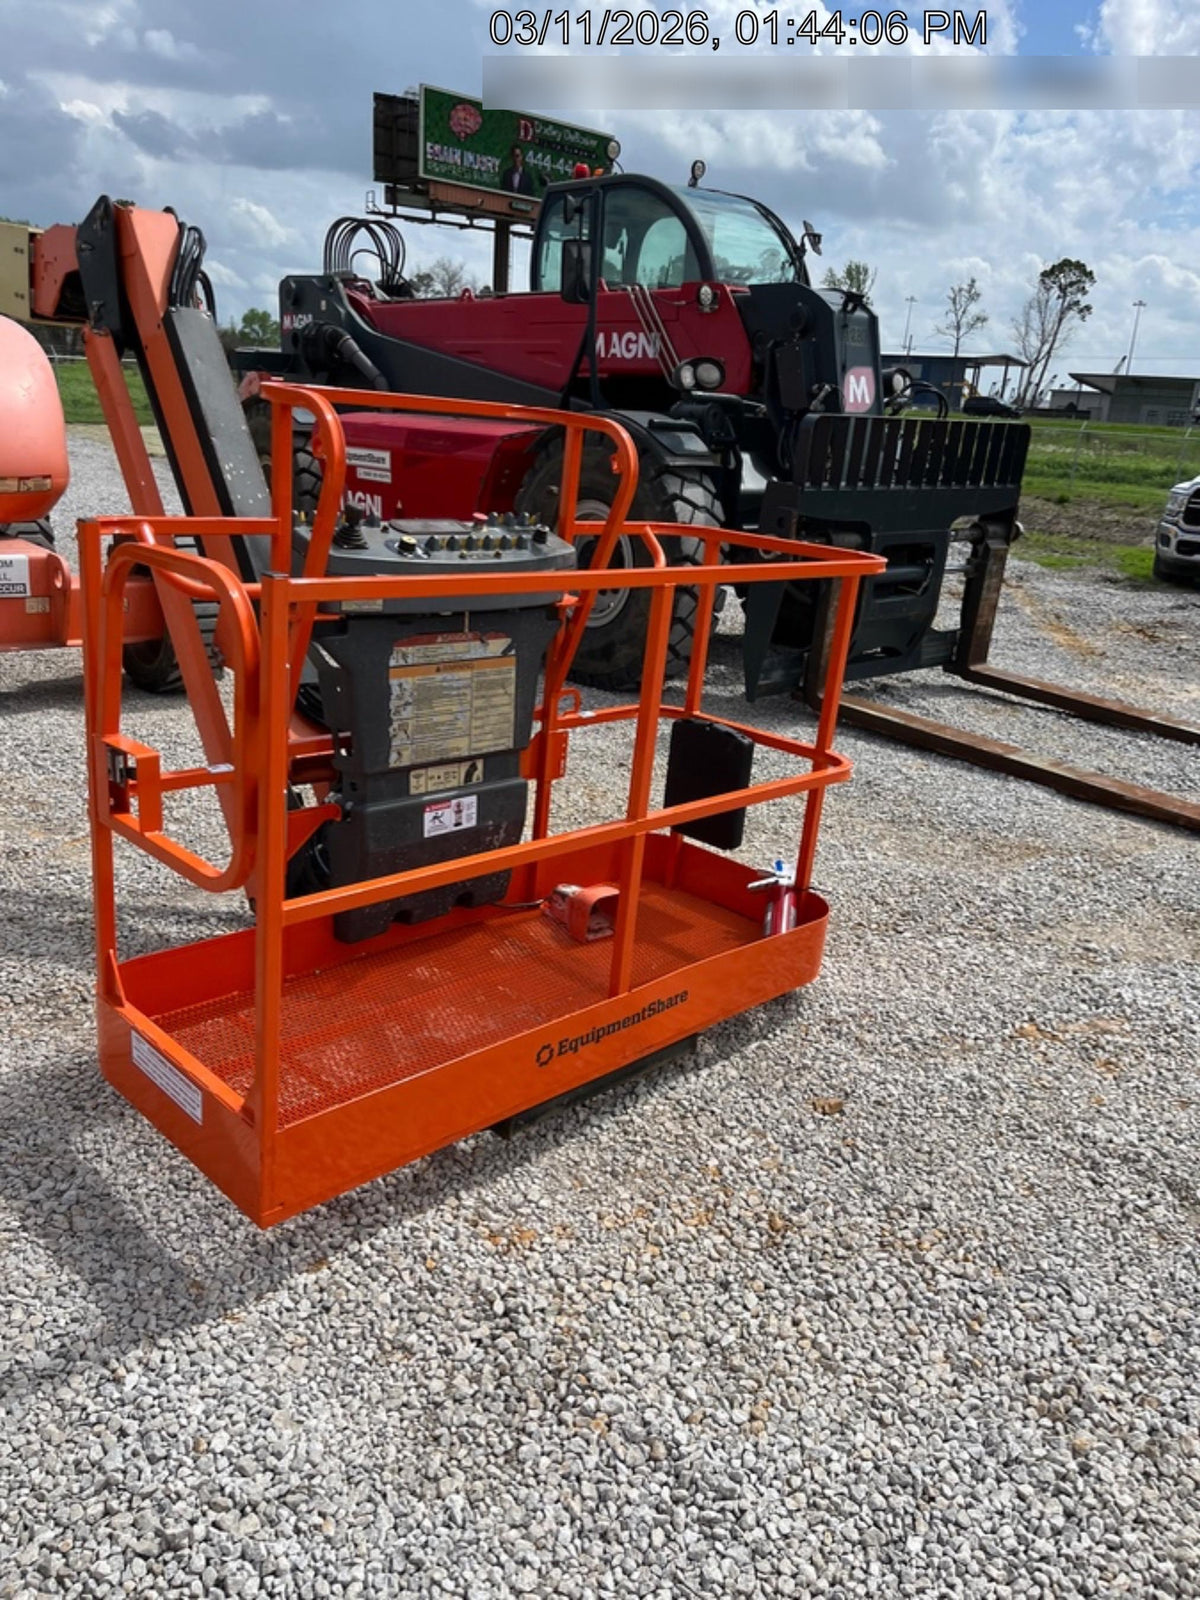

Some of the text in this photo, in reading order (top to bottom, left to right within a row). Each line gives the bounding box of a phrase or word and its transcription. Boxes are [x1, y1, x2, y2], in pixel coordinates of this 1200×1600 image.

[525, 150, 575, 177] 444-44
[283, 313, 314, 330] MAGN
[849, 376, 871, 404] M
[557, 990, 689, 1057] EquipmentShare
